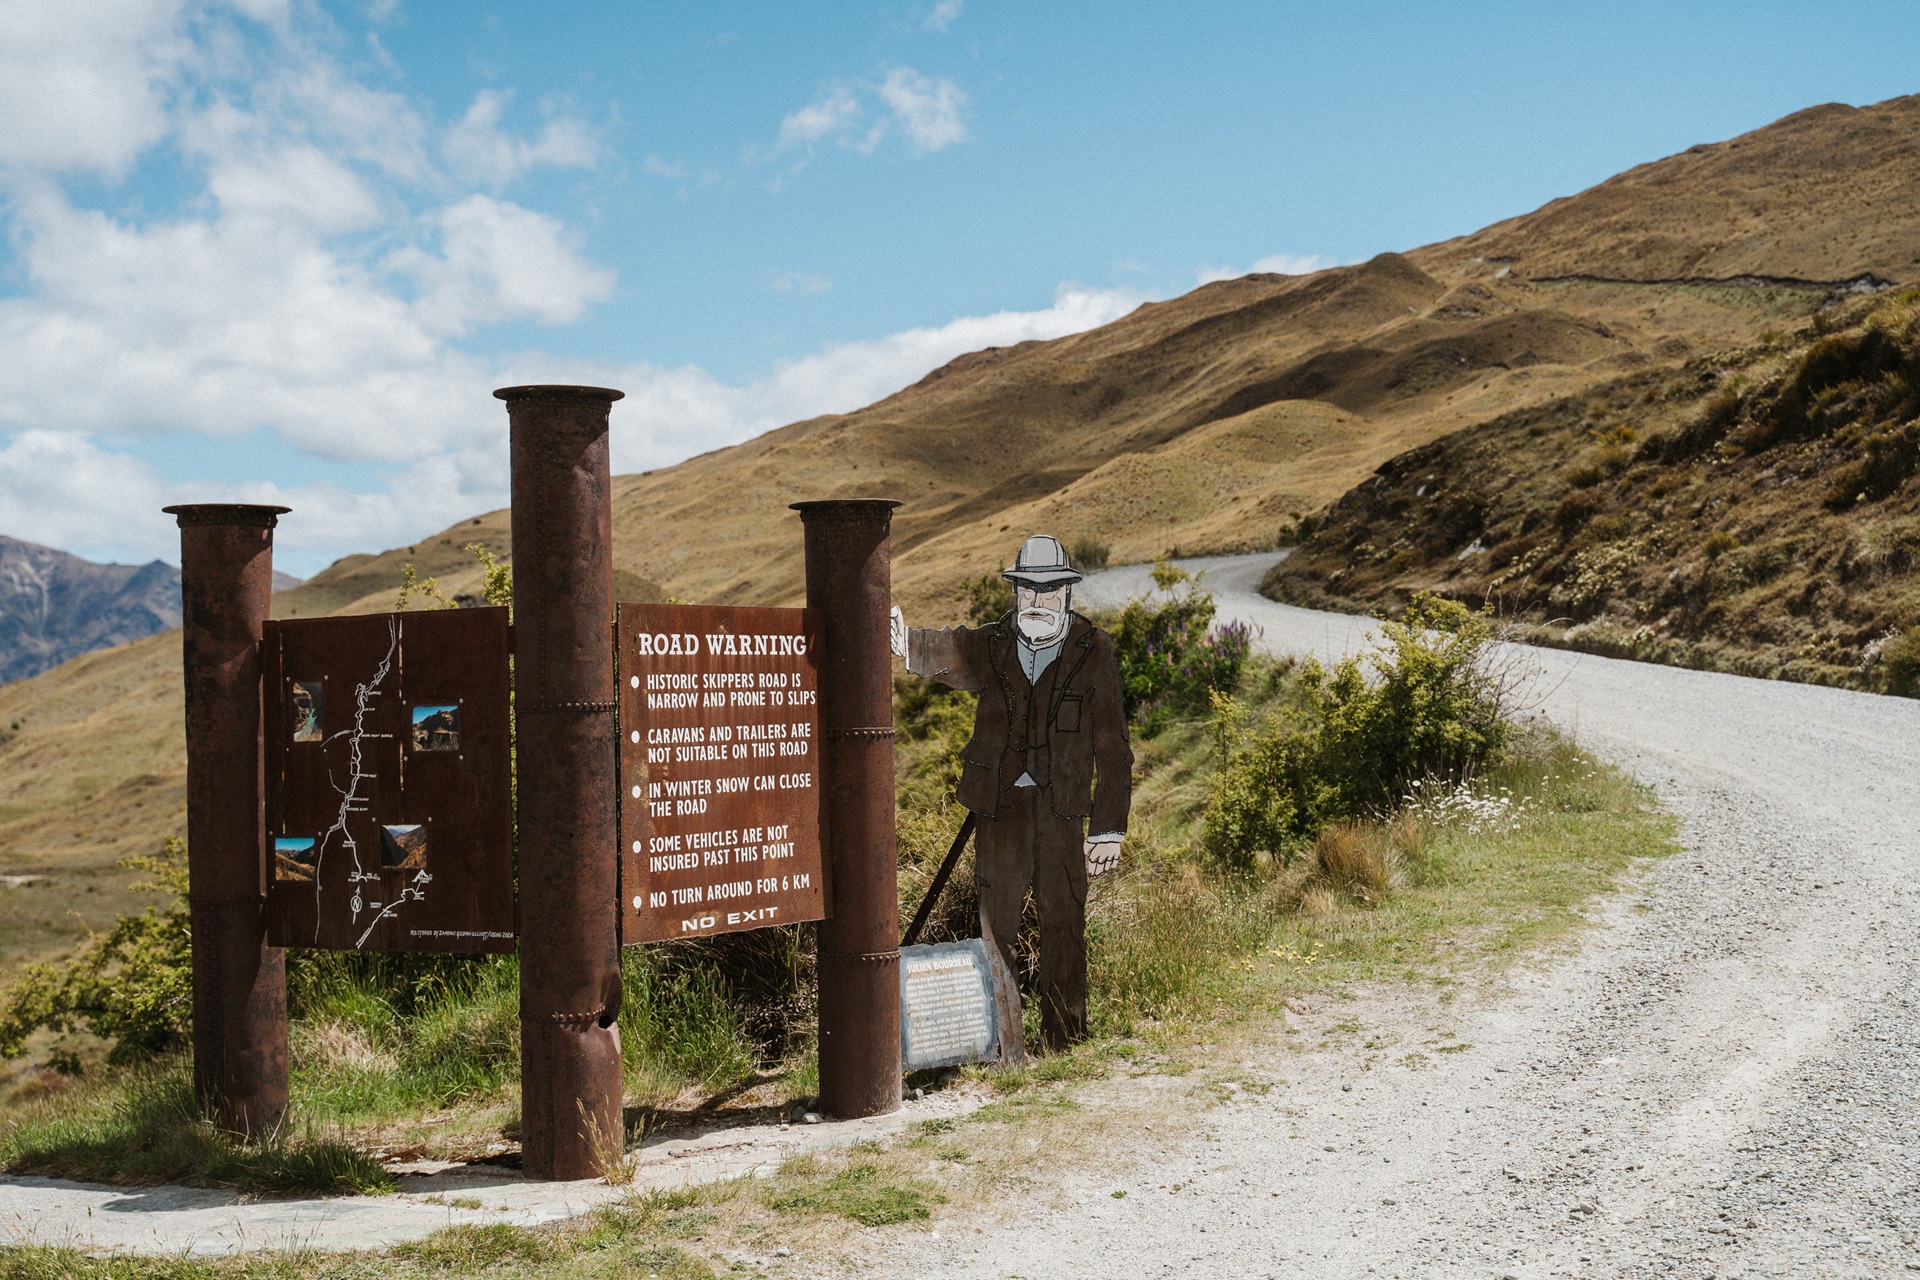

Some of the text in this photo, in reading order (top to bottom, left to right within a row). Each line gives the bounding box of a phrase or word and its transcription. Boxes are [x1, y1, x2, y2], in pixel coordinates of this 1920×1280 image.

[639, 633, 807, 655] ROAD WARNING
[647, 673, 801, 689] HISTORIC SKIPPERS ROAD IS
[648, 690, 816, 708] NARROW AND PRONE TO SLIPS
[648, 723, 811, 744] CARAVANS AND TRAILERS ARE
[648, 741, 808, 763] NOT SUITABLE ON THIS ROAD
[649, 773, 811, 798] IN WINTER SNOW CAN CLOSE
[650, 799, 707, 817] THE ROAD
[650, 825, 788, 853] SOME VEHICLES ARE NOT
[650, 842, 794, 872] INSURED PAST THIS POINT
[650, 874, 810, 908] NO TURN AROUND FOR 6 KM
[682, 907, 778, 931] NO EXIT
